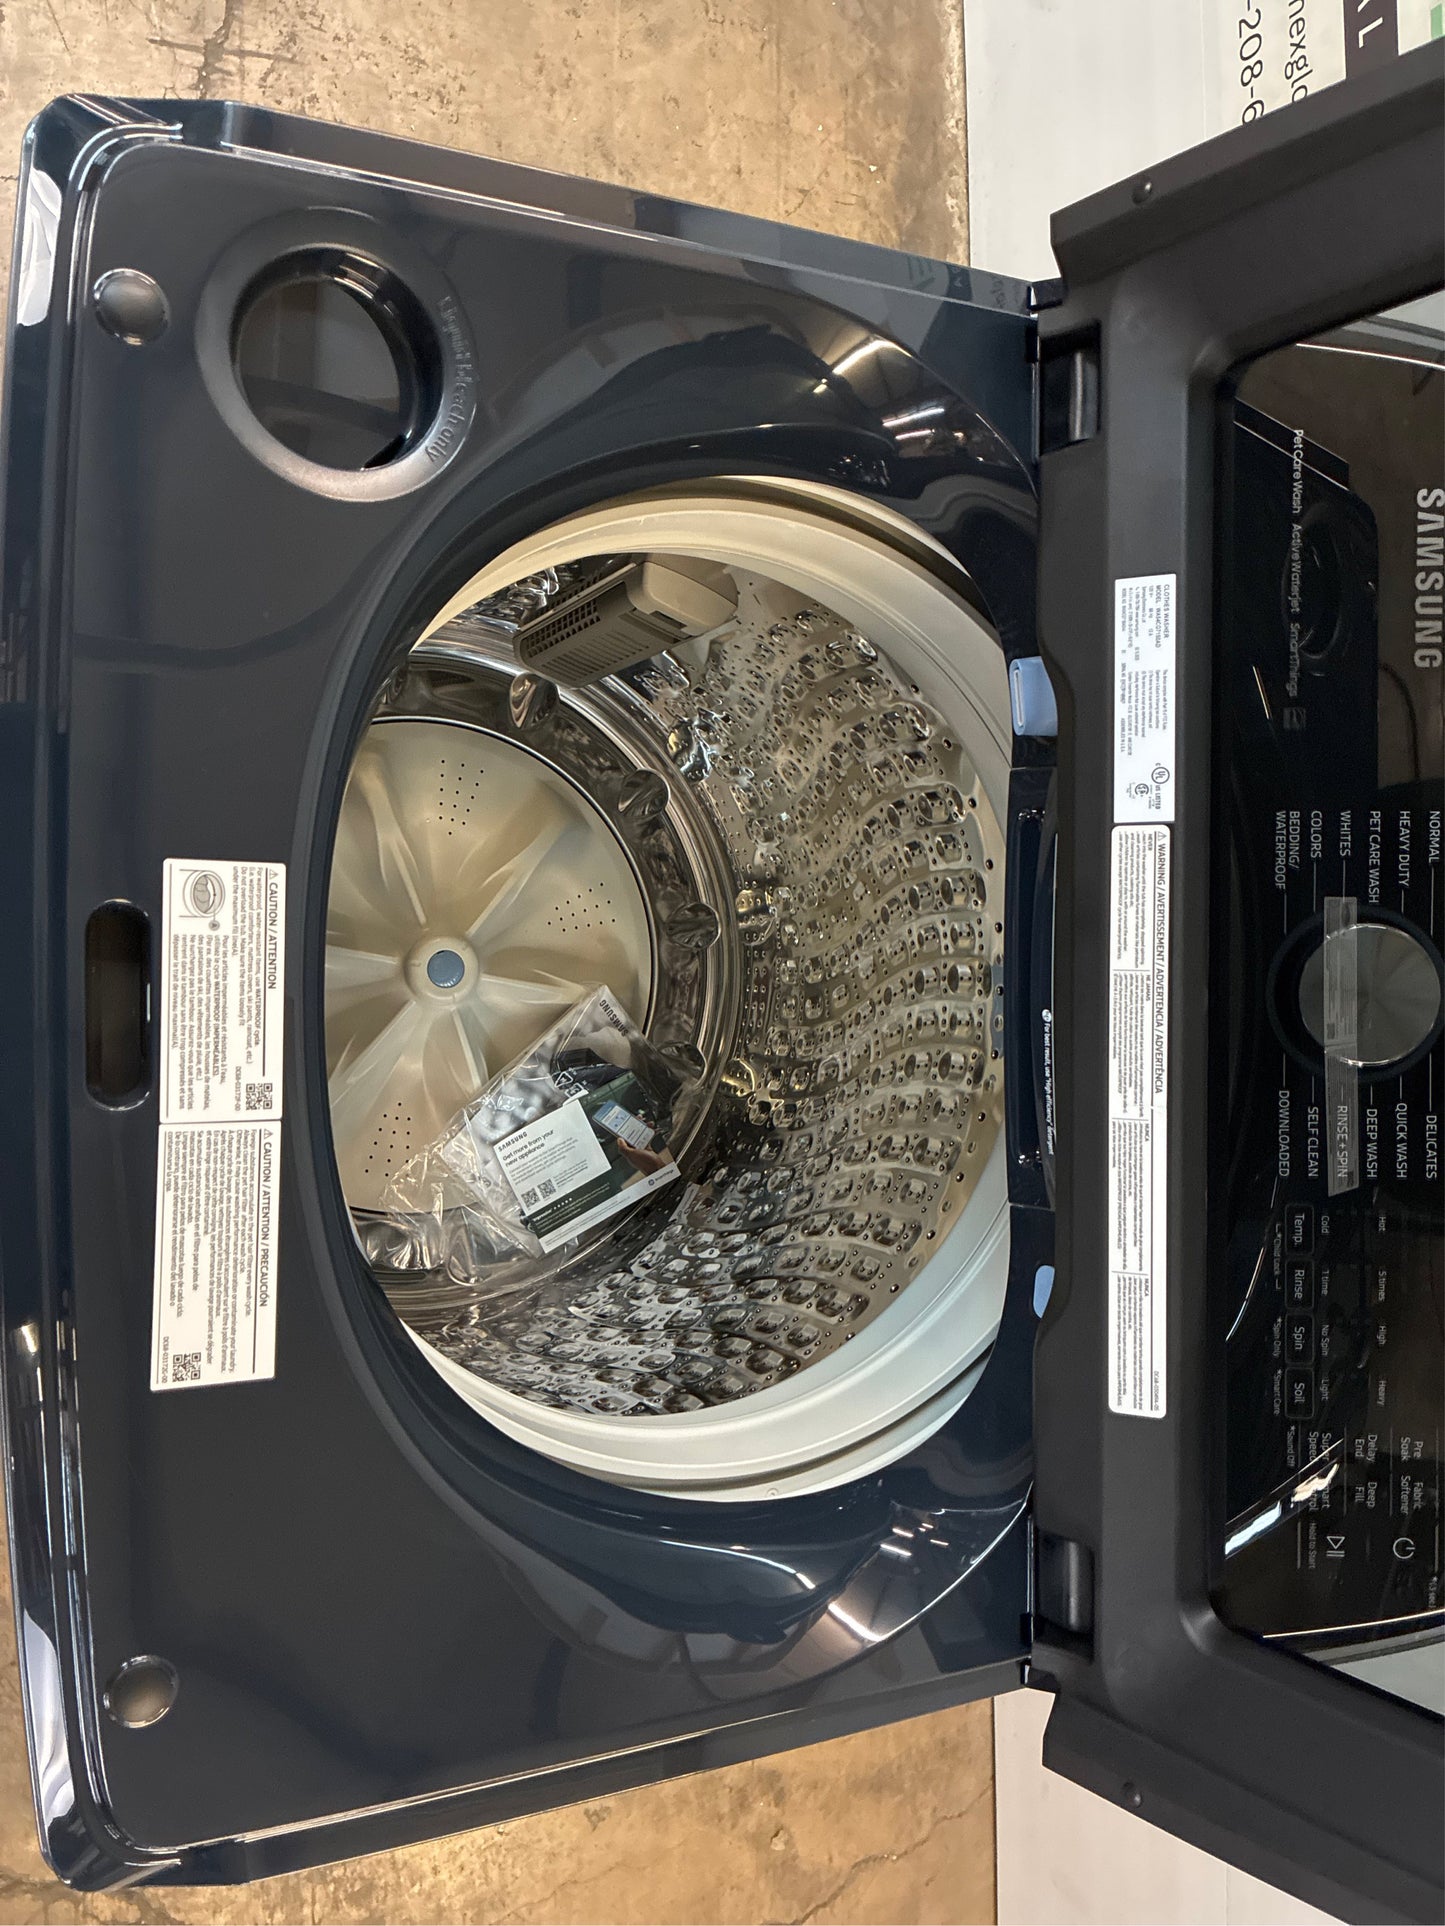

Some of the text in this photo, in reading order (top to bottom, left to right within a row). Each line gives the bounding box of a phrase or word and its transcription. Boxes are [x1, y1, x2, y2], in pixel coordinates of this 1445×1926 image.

[424, 426, 458, 462] only
[1293, 430, 1303, 448] Pet
[1293, 450, 1303, 479] Care
[1292, 481, 1303, 514] Wash
[1414, 488, 1444, 668] SAMSUNG
[1285, 623, 1300, 696] SmartThings
[1288, 811, 1300, 869] BEDDING/
[1310, 810, 1322, 858] COLORS
[1340, 810, 1351, 856] WHITES
[1399, 810, 1410, 887] HEAVY DUTY
[1429, 810, 1440, 863] NORMAL
[1157, 843, 1166, 886] WARNING
[1275, 810, 1286, 890] WATERPROOF
[1368, 811, 1380, 903] PET CARE WASH
[268, 882, 278, 926] CAUTION
[1156, 892, 1165, 961] AVERTISSEMENT
[267, 935, 277, 989] ATTENTION
[1155, 968, 1164, 1028] ADVERTENCIA
[600, 1000, 628, 1037] SAMSUNG
[1155, 1034, 1165, 1093] ADVERTÊNCIA
[498, 1132, 527, 1152] SAMSUNG
[503, 1130, 553, 1161] Get more from your
[1279, 1090, 1290, 1177] DOWNLOADED
[1307, 1106, 1319, 1177] SELF CLEAN
[1366, 1108, 1378, 1178] DEEP WASH
[1396, 1102, 1408, 1178] QUICK WASH
[1426, 1115, 1437, 1179] DELICATES
[263, 1142, 272, 1182] CAUTION
[505, 1143, 545, 1167] new appliance
[261, 1190, 270, 1240] ATTENTION
[1292, 1213, 1304, 1247] Temp.
[1321, 1216, 1330, 1234] Cold
[1378, 1216, 1386, 1232] Hot
[259, 1248, 270, 1307] PRECAUCIÓN
[1294, 1270, 1304, 1299] Rinse
[1378, 1278, 1386, 1301] times
[1272, 1341, 1281, 1357] Only
[1292, 1327, 1305, 1350] Spin
[1320, 1325, 1329, 1356] No Spin
[1376, 1326, 1387, 1344] High
[1294, 1383, 1305, 1403] Soil
[1319, 1380, 1329, 1400] Light
[1376, 1380, 1386, 1406] Heavy
[1273, 1399, 1281, 1415] Care
[1320, 1433, 1331, 1461] Super
[1355, 1439, 1364, 1457] End
[1366, 1434, 1378, 1462] Delay
[1401, 1437, 1411, 1461] Soak
[1413, 1441, 1424, 1458] Pre
[1355, 1487, 1364, 1502] Fill
[1366, 1482, 1378, 1508] Deep
[1401, 1475, 1411, 1515] Softener
[1413, 1482, 1424, 1510] Fabric
[1309, 1541, 1316, 1549] to
